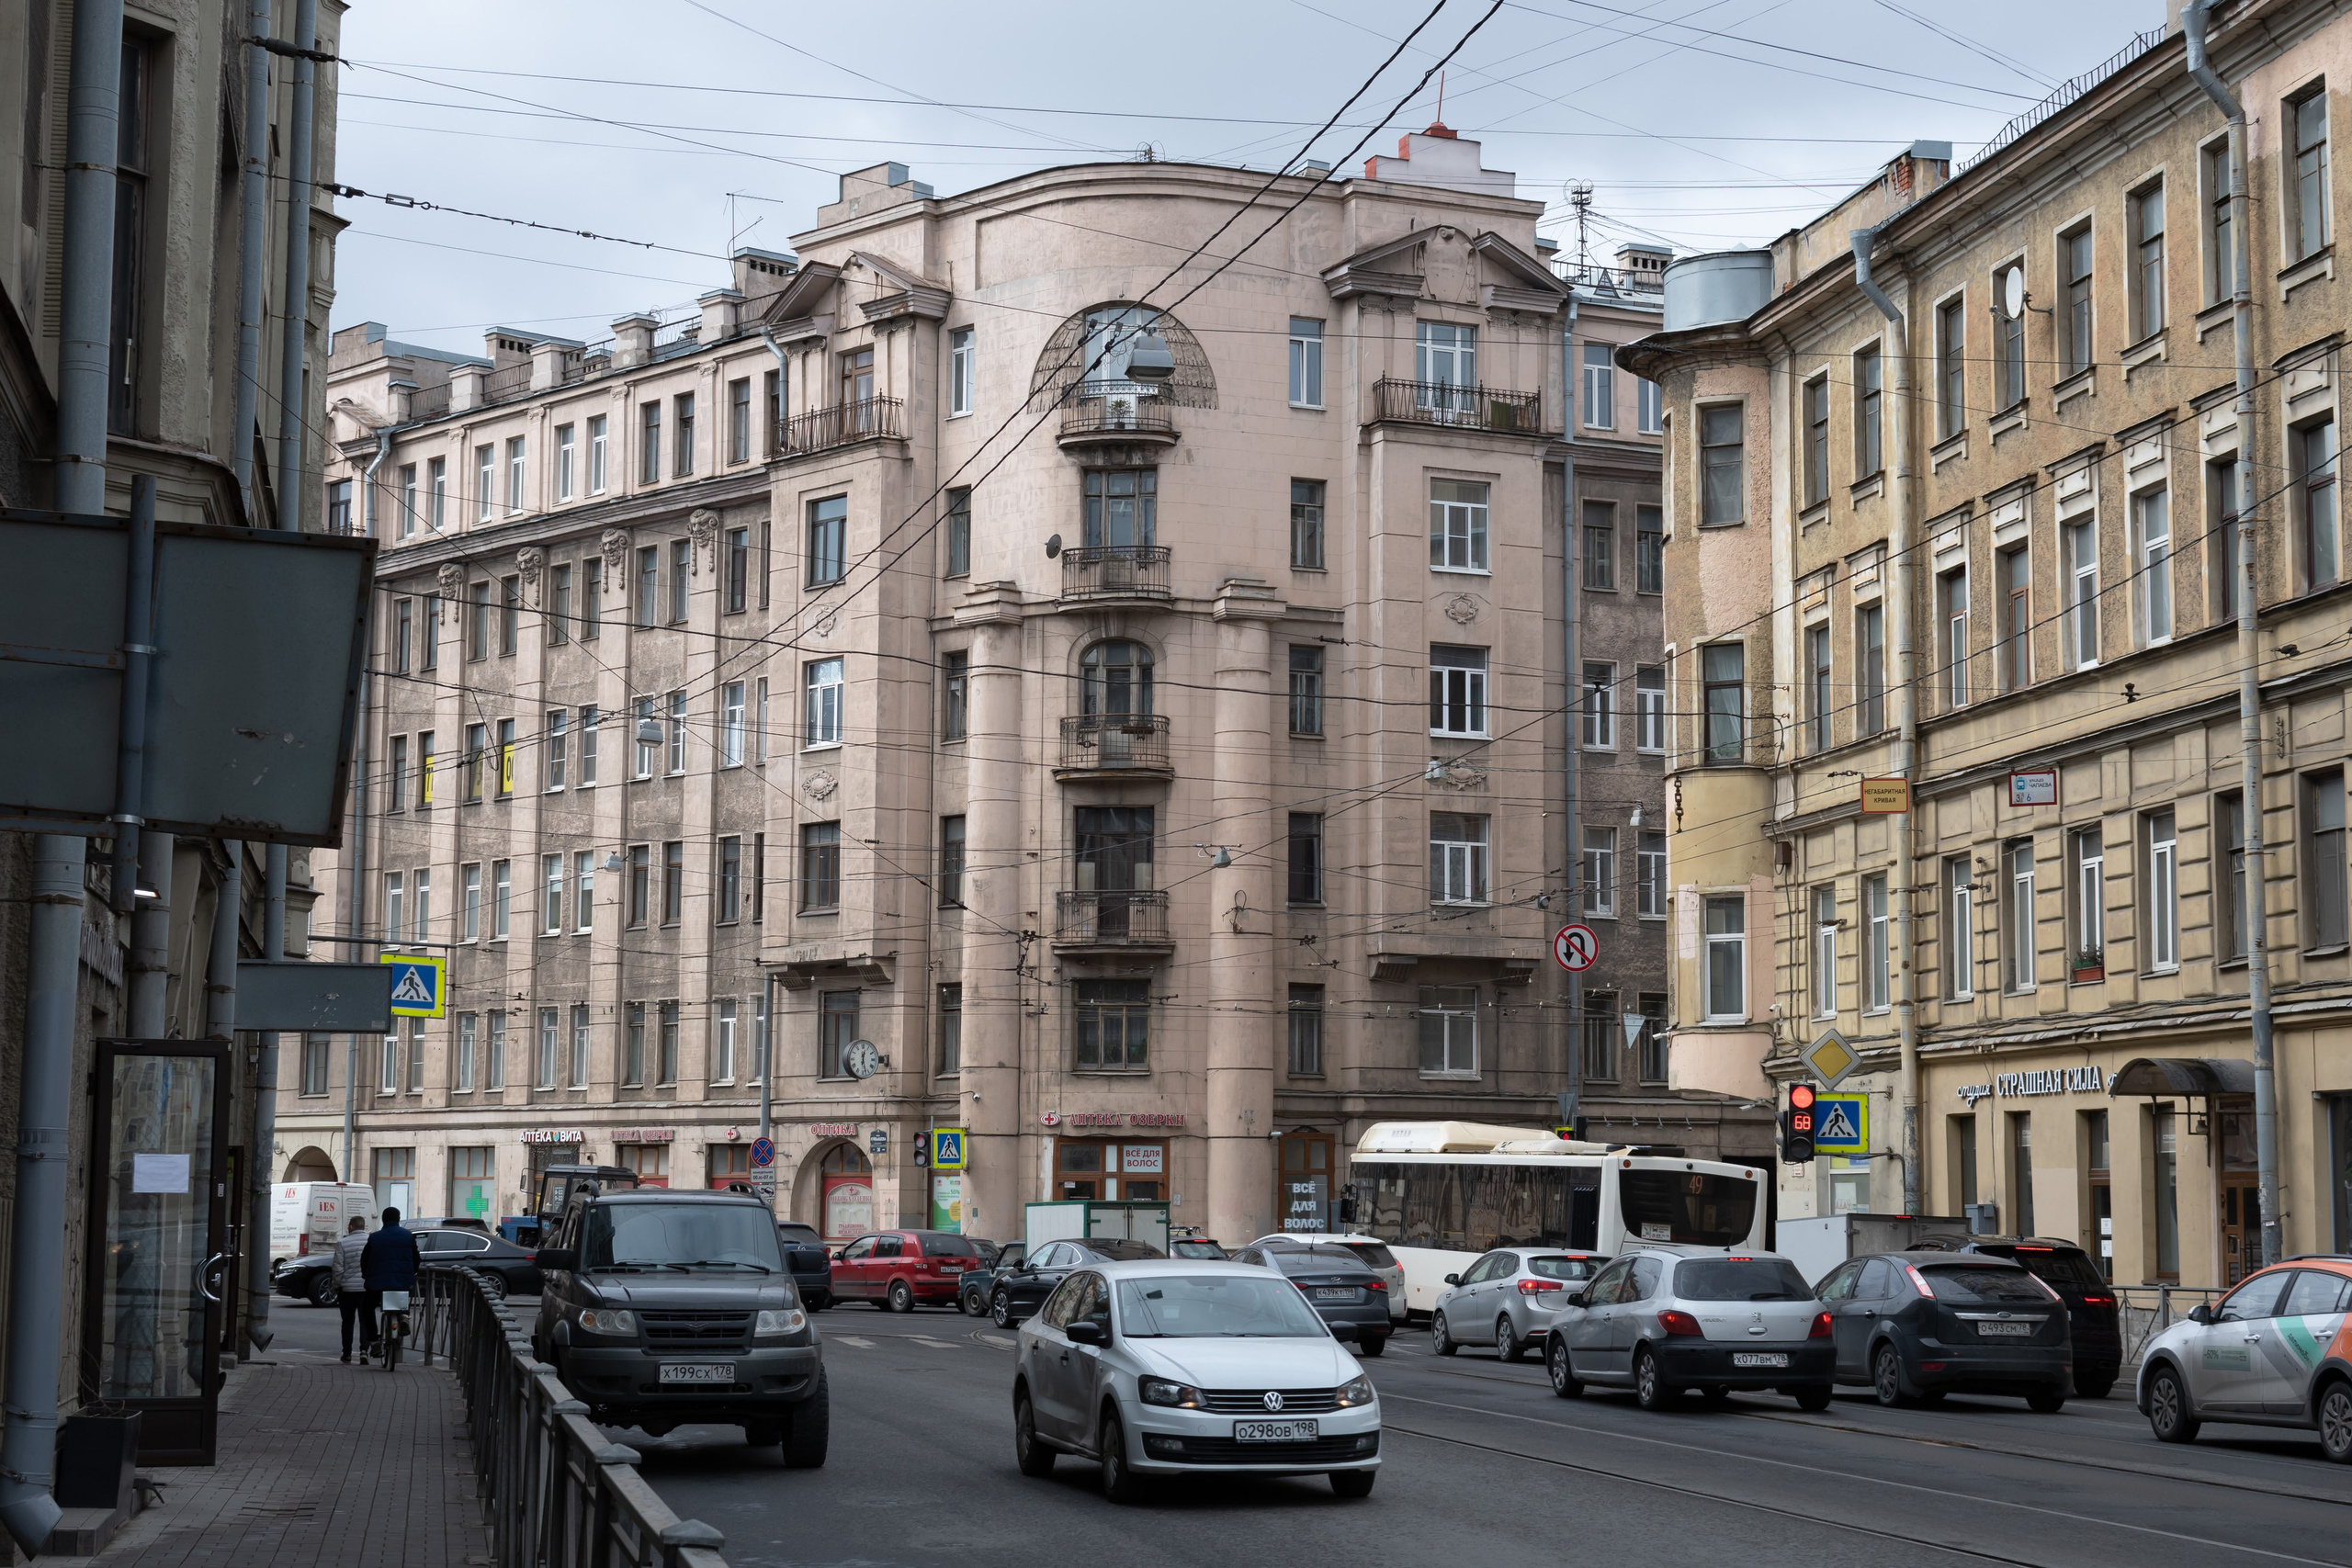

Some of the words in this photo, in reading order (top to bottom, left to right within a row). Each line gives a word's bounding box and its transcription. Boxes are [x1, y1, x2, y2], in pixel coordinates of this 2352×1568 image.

[2026, 793, 2031, 802] 6
[1957, 1084, 1991, 1108] студия
[1996, 1069, 2063, 1096] СТРАШНАЯ
[2066, 1066, 2101, 1091] СИЛА
[1069, 1113, 1123, 1126] АПТЕКА
[1129, 1113, 1185, 1126] ОЗЕРКИ
[1794, 1115, 1811, 1130] 68
[610, 1130, 640, 1140] АПТЕКА
[641, 1129, 673, 1140] ОЗЕРКИ
[810, 1123, 855, 1135] ОПТИКА
[519, 1131, 552, 1143] АПТЕКА
[560, 1130, 582, 1142] ВИТА
[1125, 1148, 1141, 1157] ВСЁ
[1142, 1149, 1160, 1158] ДЛЯ
[1126, 1159, 1159, 1168] ВОЛОС
[1293, 1180, 1316, 1193] ВСЁ
[1689, 1175, 1703, 1194] 49
[285, 1188, 298, 1198] iES
[319, 1201, 335, 1212] iES
[1290, 1201, 1316, 1213] ДЛЯ
[1284, 1218, 1324, 1229] ВОЛОС
[714, 1366, 731, 1376] 178
[1295, 1422, 1314, 1433] 198
